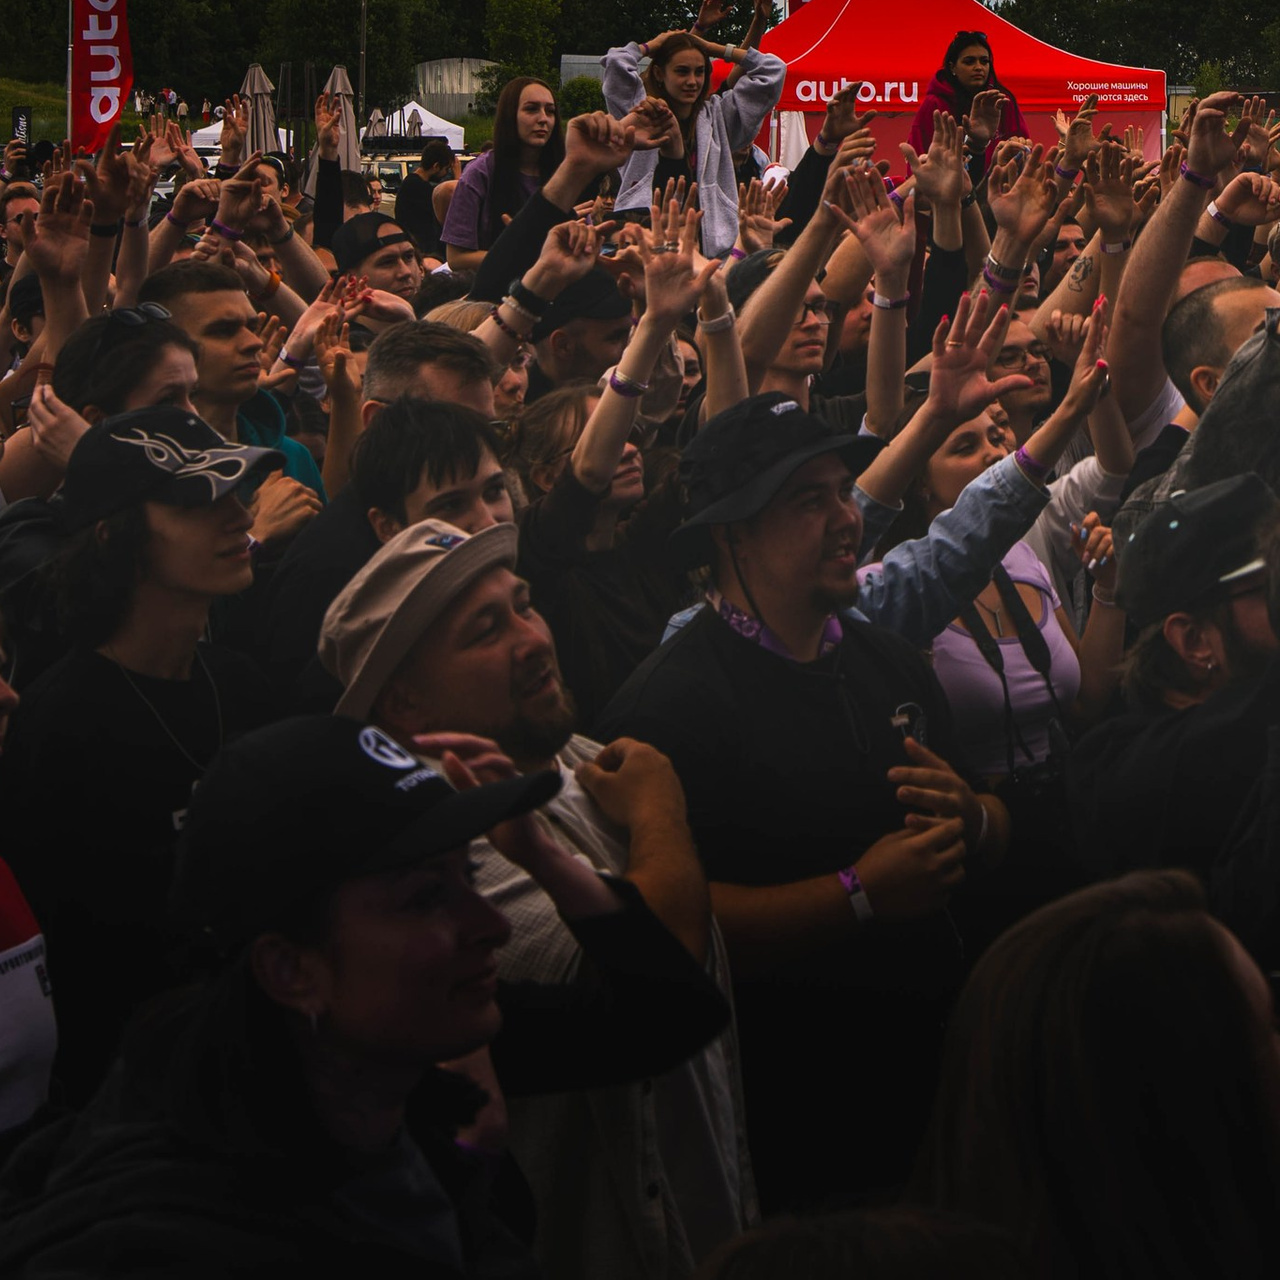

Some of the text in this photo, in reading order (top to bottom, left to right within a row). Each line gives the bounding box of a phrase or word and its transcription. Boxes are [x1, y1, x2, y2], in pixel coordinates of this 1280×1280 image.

[1067, 81, 1148, 91] Хорошие машины
[1072, 94, 1149, 102] проются здесь
